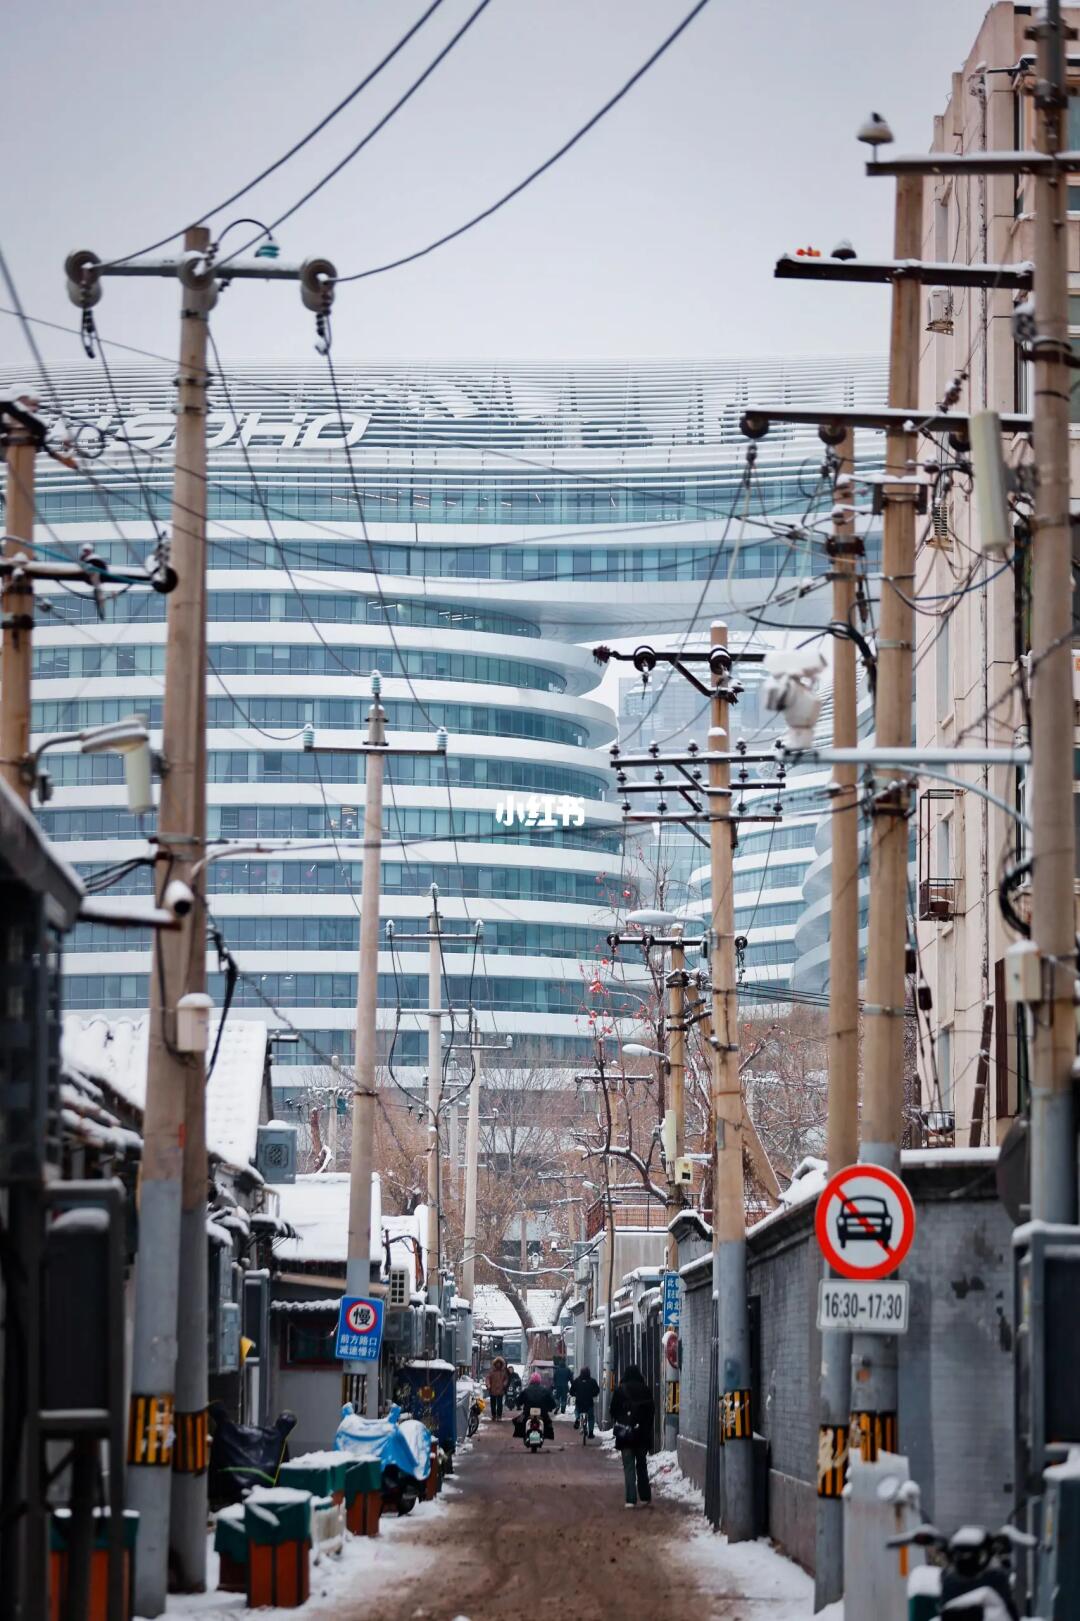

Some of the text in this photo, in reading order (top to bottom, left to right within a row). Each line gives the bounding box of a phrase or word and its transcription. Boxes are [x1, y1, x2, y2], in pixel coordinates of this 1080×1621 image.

[106, 412, 373, 449] SOHO
[353, 1307, 371, 1326] 慢
[824, 1292, 903, 1320] 16:30-17:30
[340, 1334, 378, 1346] 前方路口
